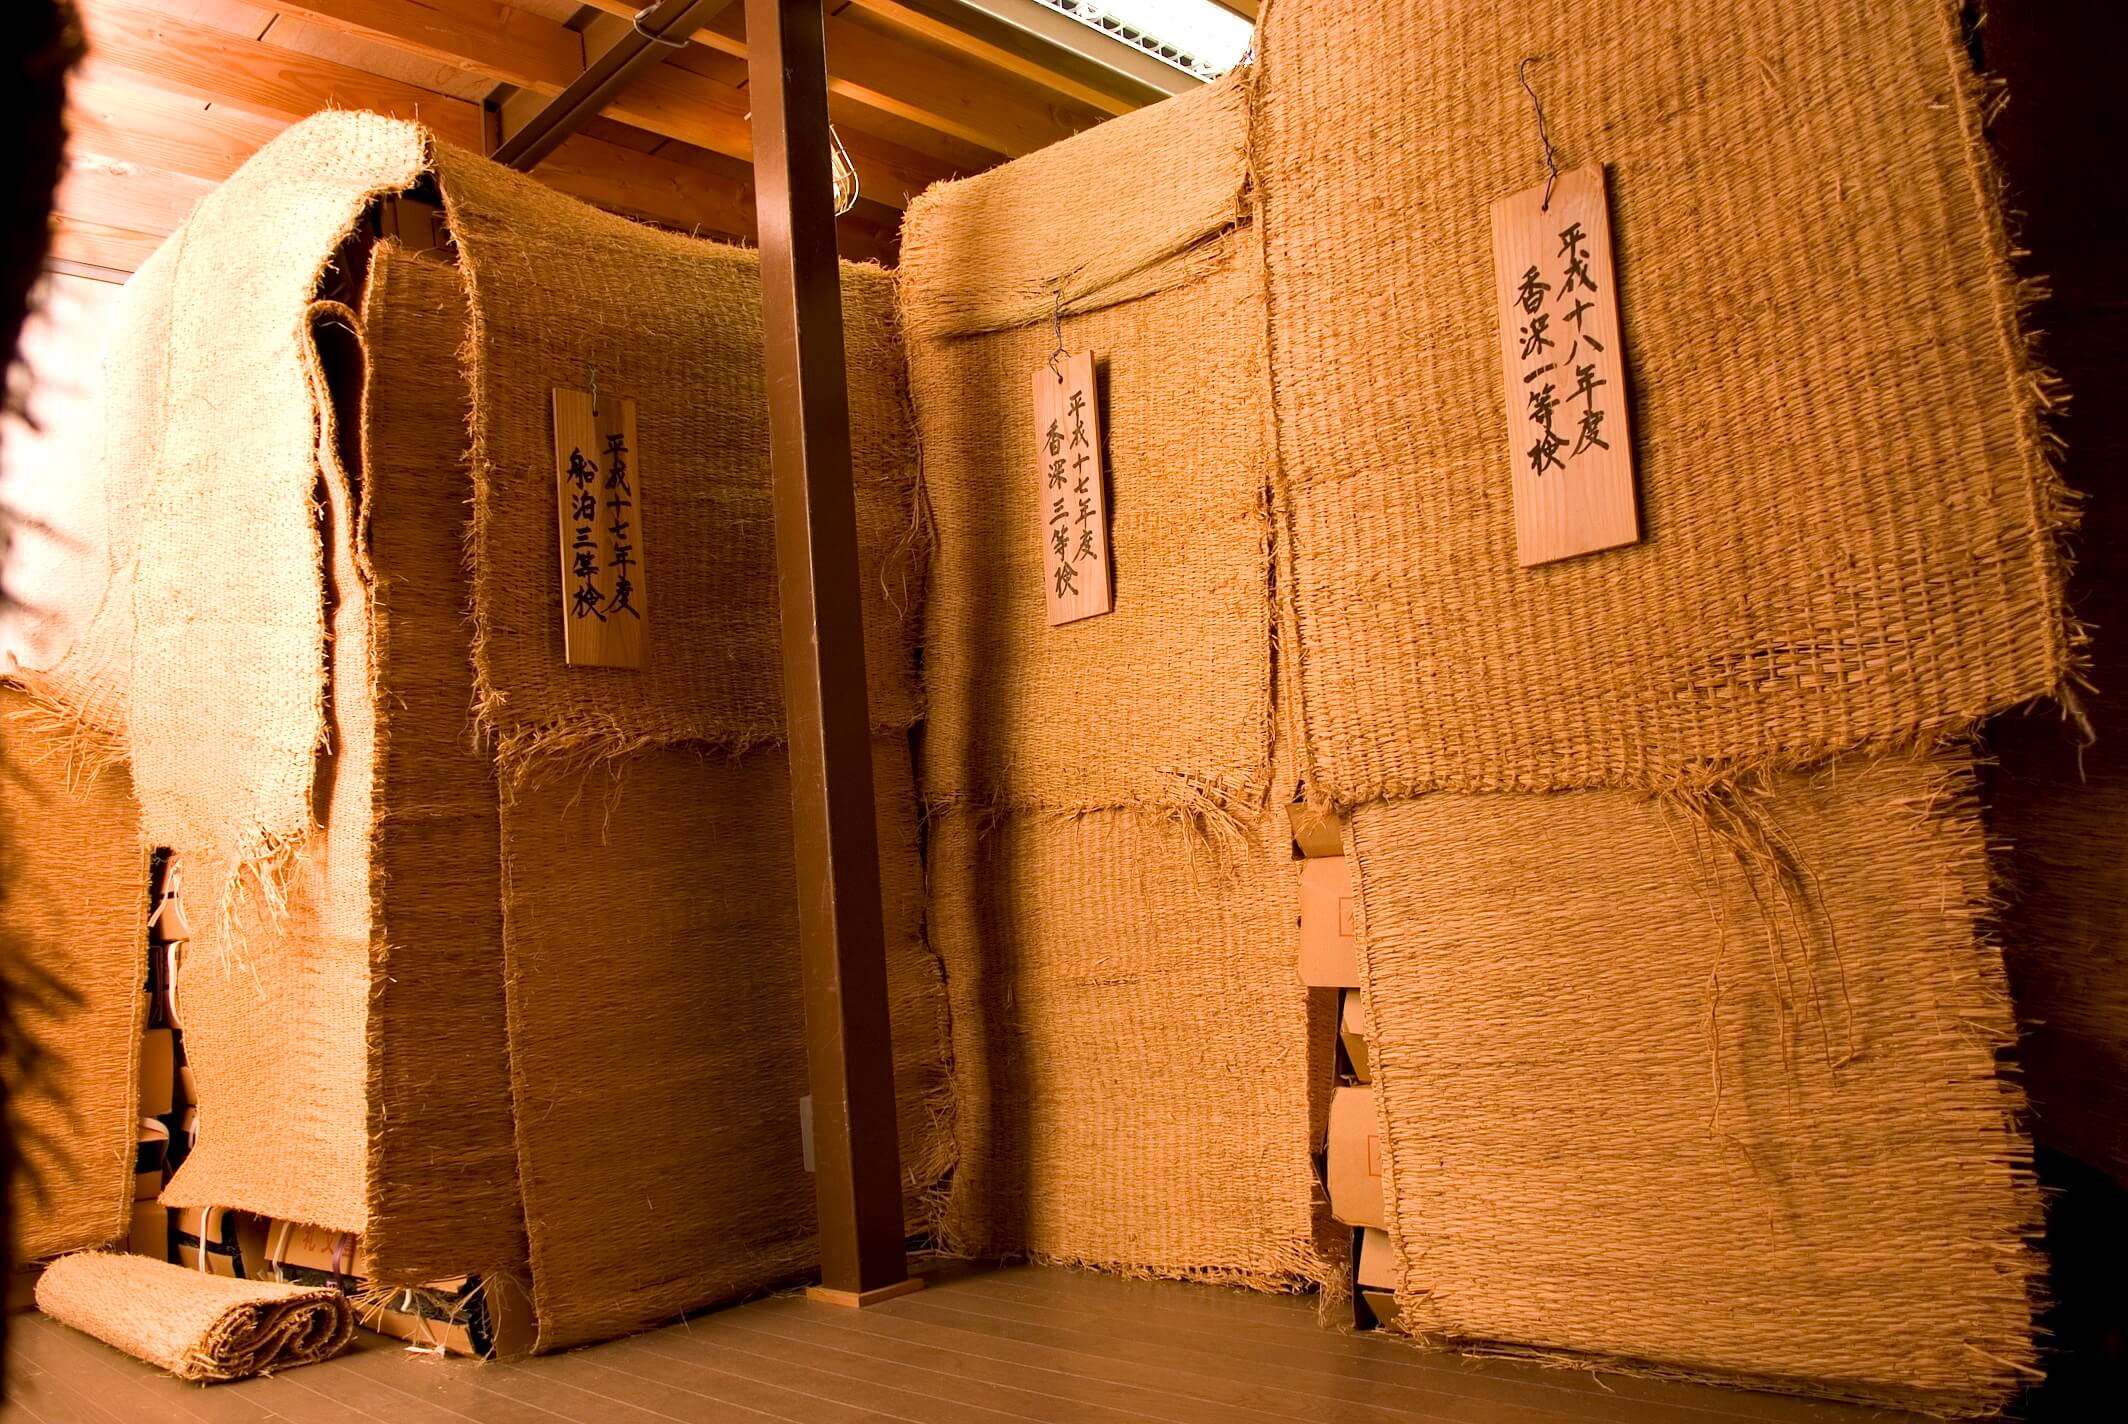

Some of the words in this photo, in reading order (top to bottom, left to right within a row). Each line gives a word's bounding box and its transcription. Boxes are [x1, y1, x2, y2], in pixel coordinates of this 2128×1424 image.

[1514, 265, 1569, 476] 香深一等検
[1557, 222, 1609, 458] 平成十八年度
[567, 447, 606, 621] 船泊三等検
[603, 434, 640, 619] 平成十七年度
[1043, 418, 1078, 597] 香深三等検
[1068, 389, 1097, 562] 平成十七年度
